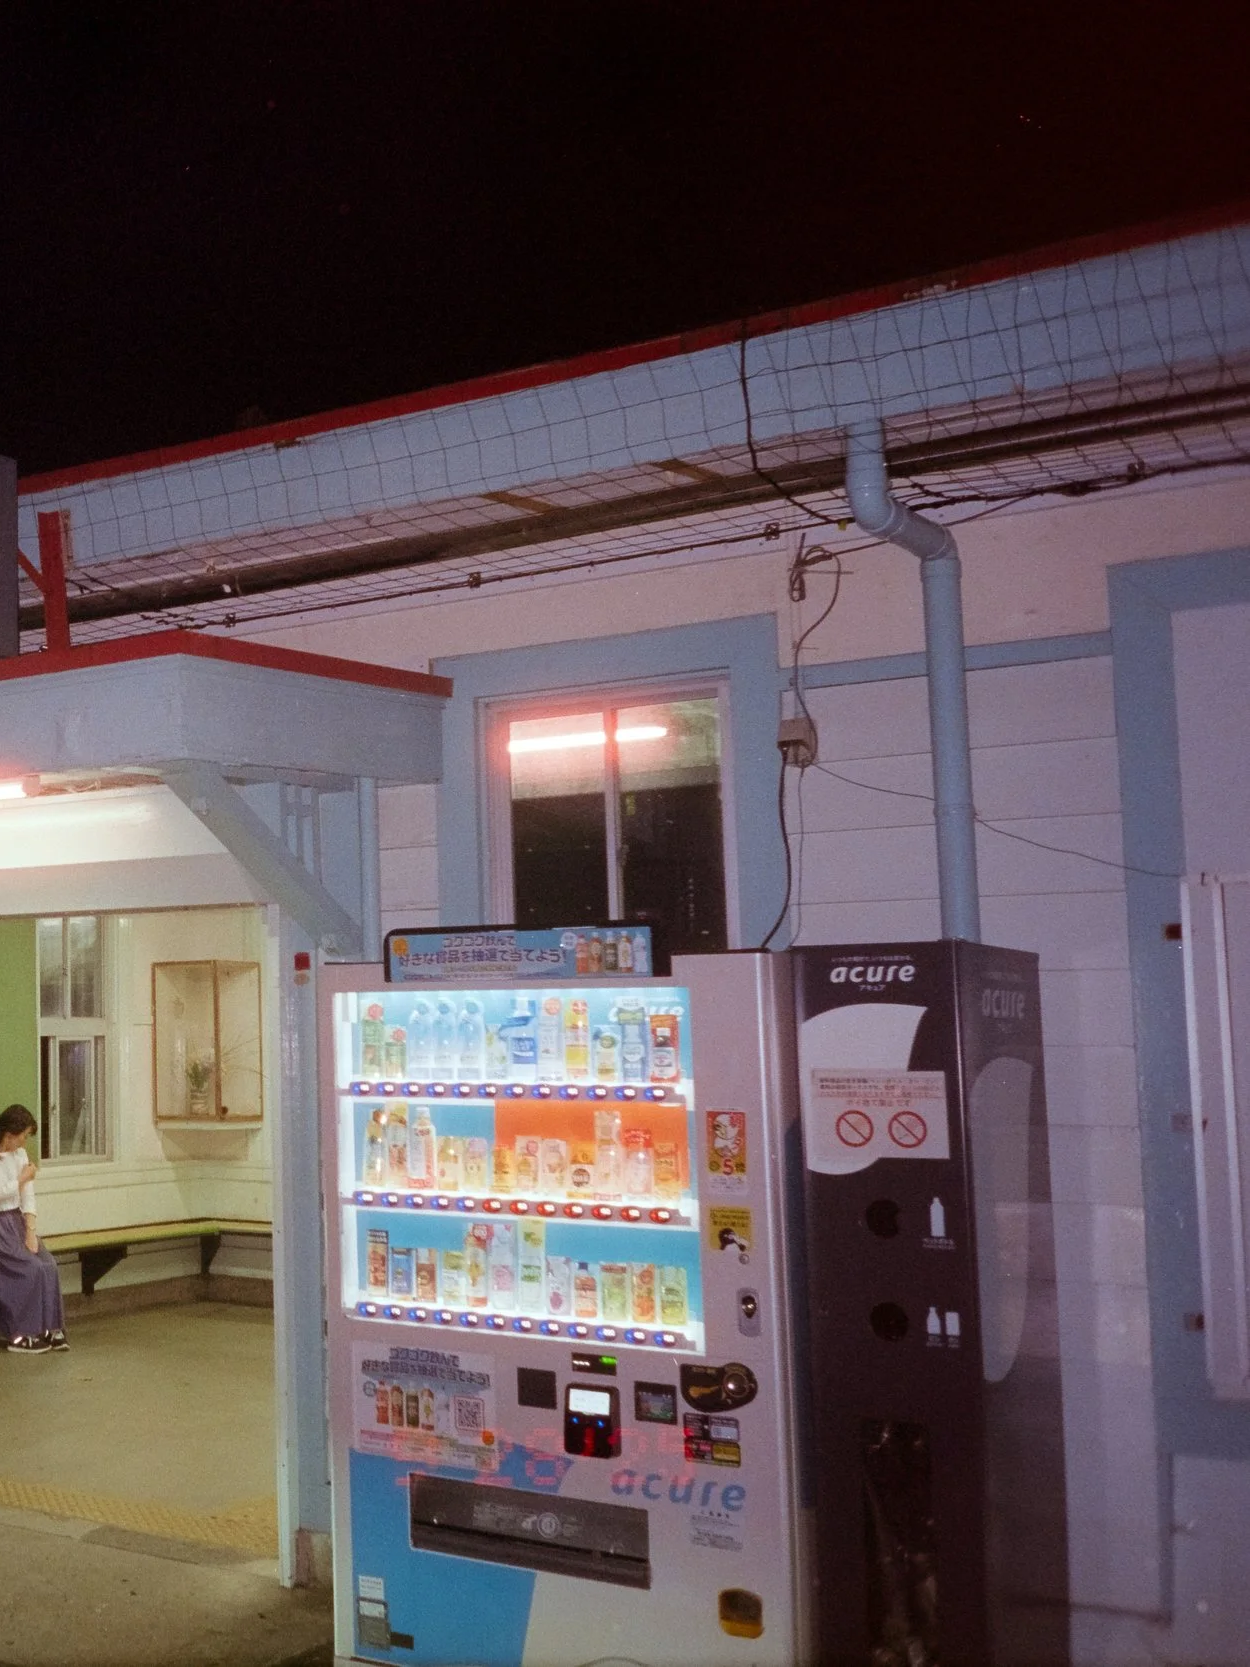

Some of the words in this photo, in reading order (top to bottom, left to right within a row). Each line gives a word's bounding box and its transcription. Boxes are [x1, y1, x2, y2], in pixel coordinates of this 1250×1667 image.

[830, 964, 916, 983] acure
[981, 987, 1025, 1019] acure
[610, 1467, 747, 1512] acure
